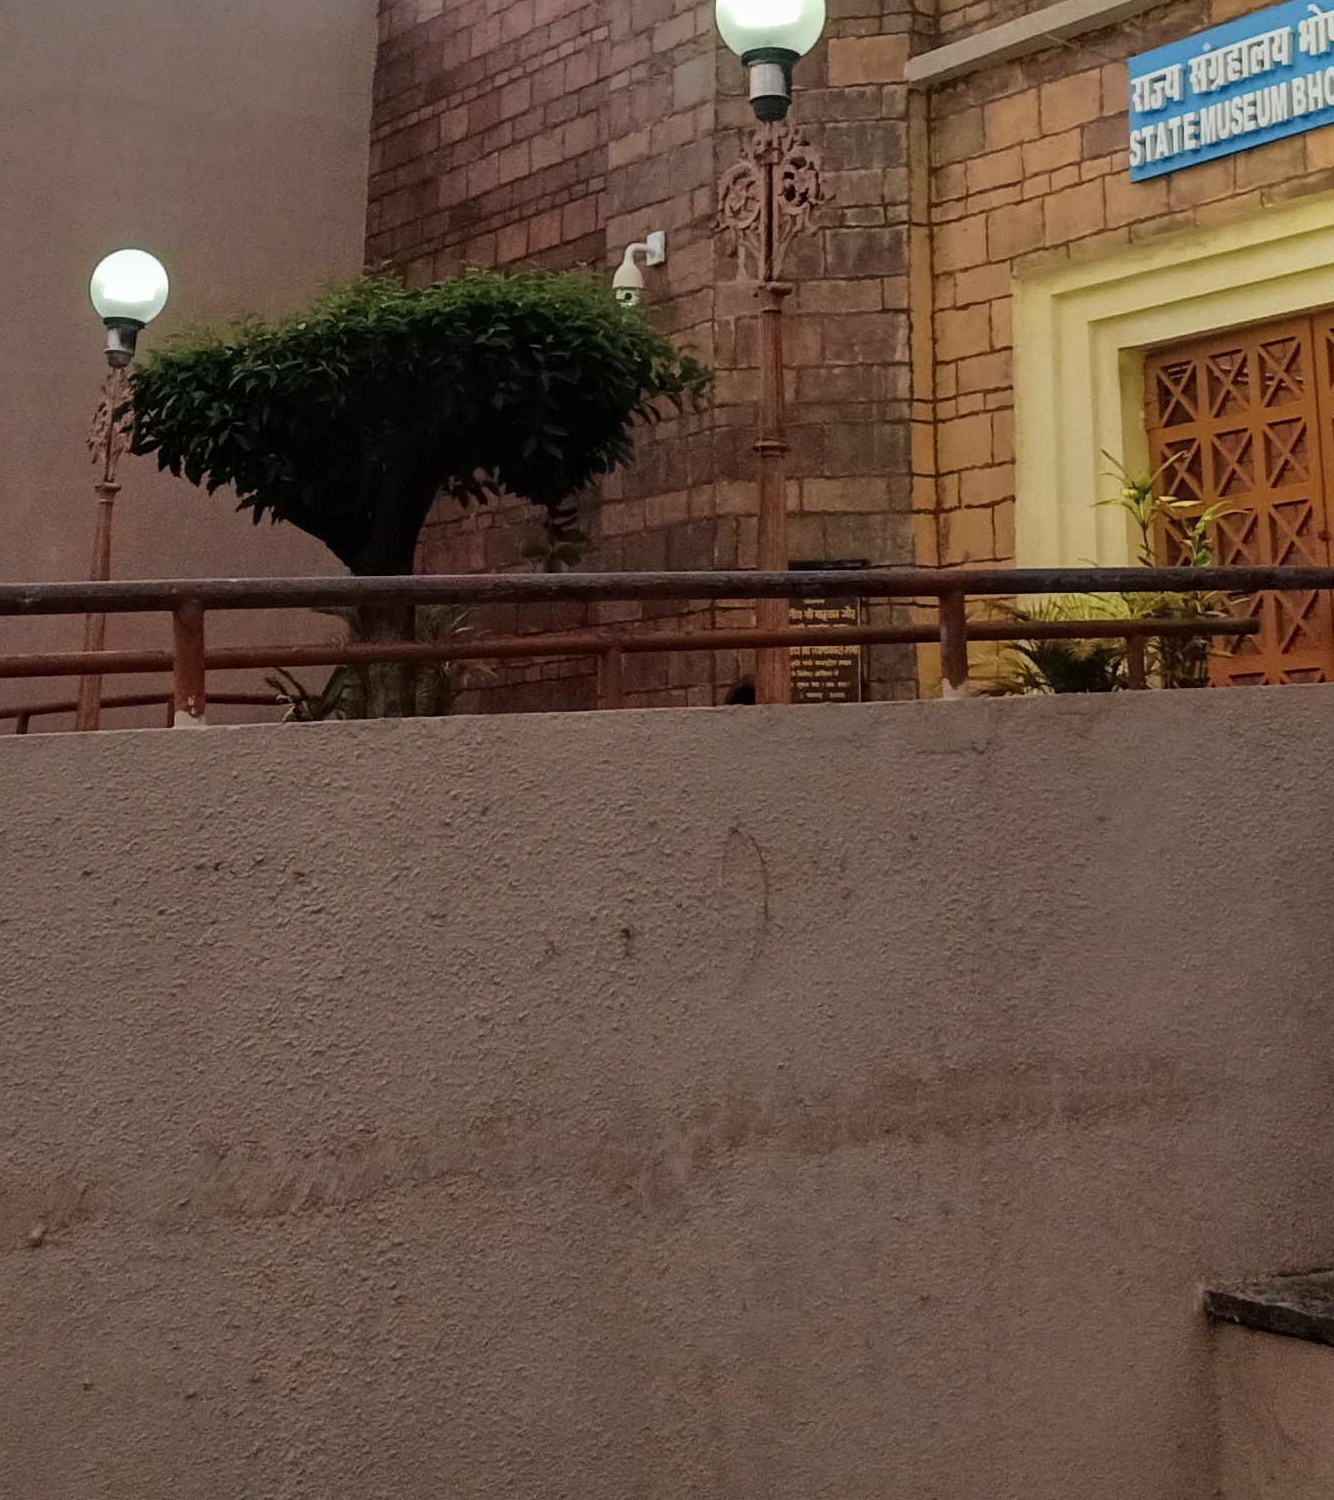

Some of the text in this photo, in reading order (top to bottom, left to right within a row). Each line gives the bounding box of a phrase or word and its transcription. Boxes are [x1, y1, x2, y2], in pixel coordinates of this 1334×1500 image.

[1131, 62, 1184, 112] राज्य
[1188, 26, 1295, 93] संग्रहालय
[1129, 112, 1199, 167] STATE
[1200, 83, 1291, 145] MUSEUM
